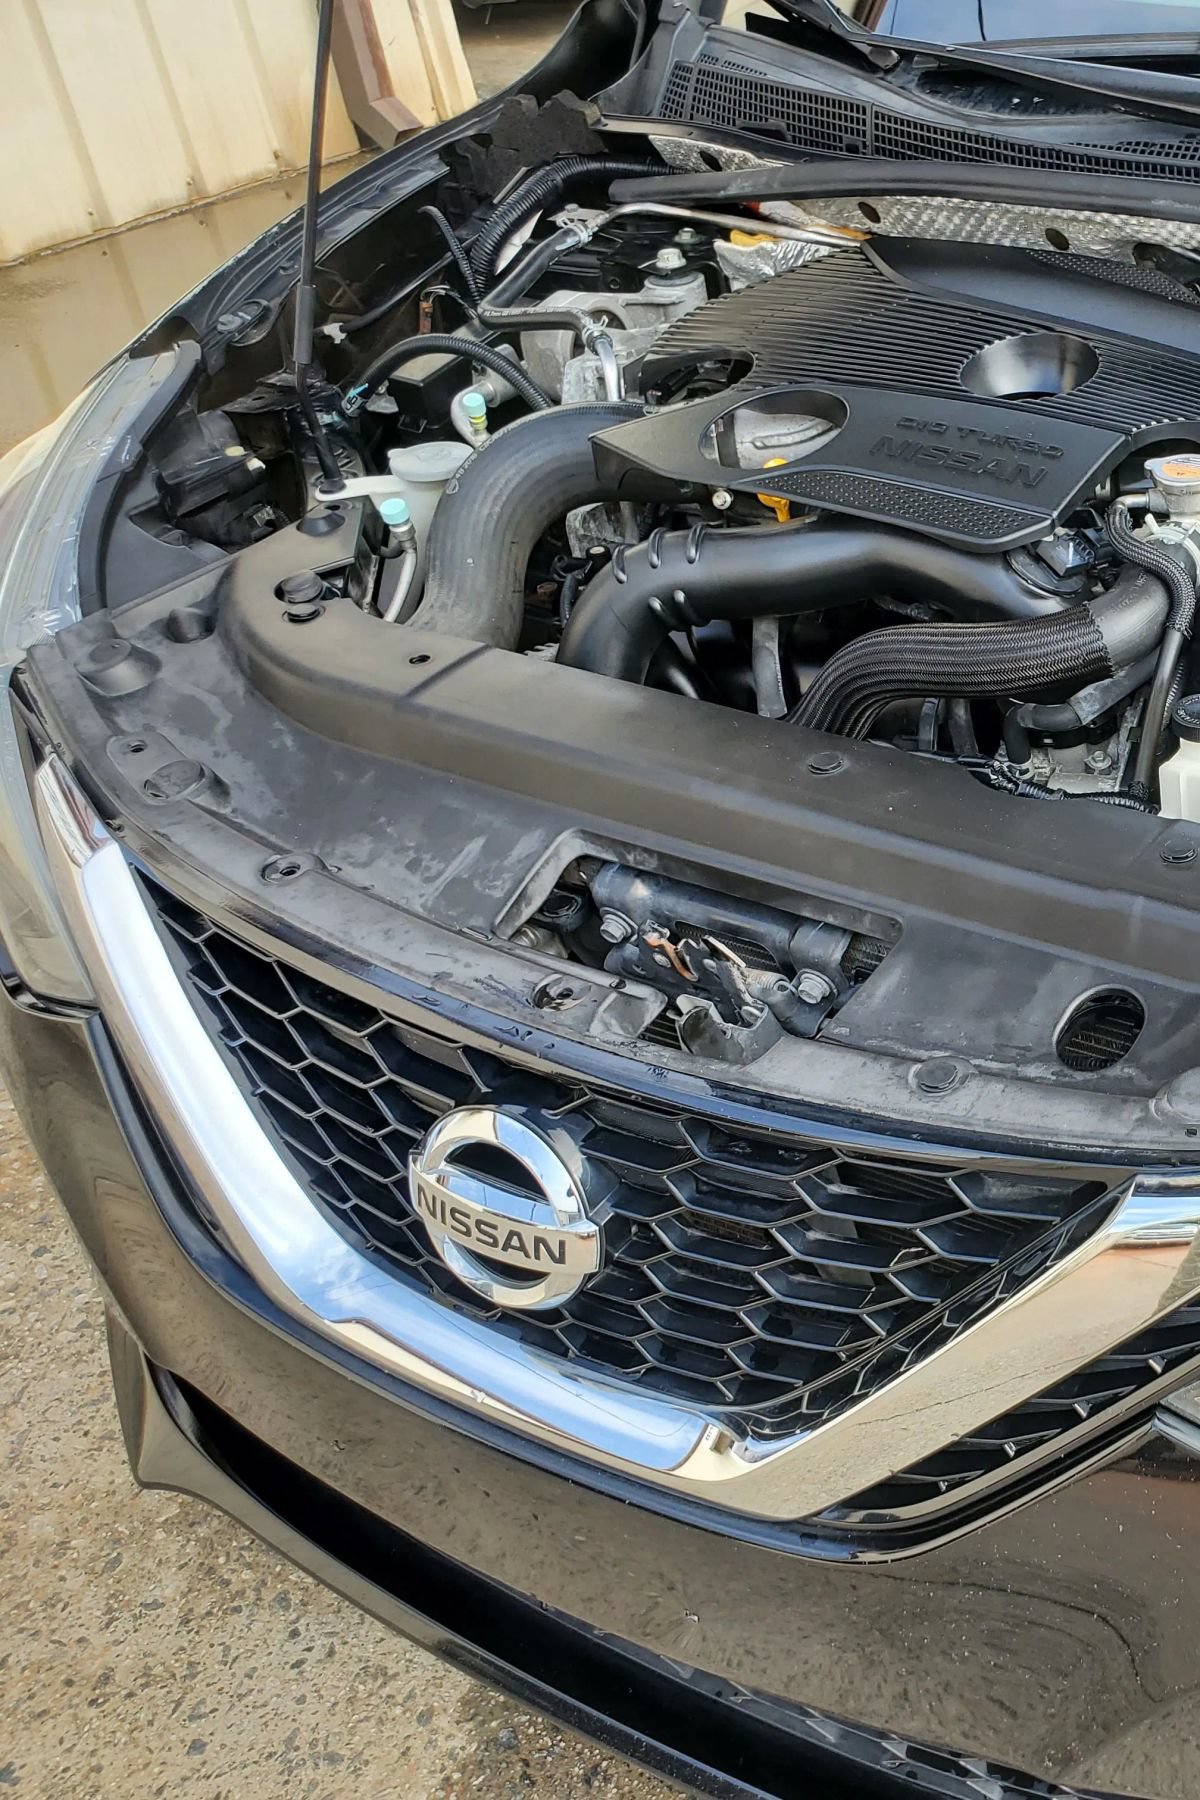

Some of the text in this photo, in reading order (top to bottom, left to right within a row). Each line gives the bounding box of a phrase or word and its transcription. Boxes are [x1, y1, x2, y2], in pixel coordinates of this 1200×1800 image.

[869, 434, 1049, 488] NISSAN
[957, 426, 1065, 457] TURBO
[417, 1181, 567, 1265] NISSAN
